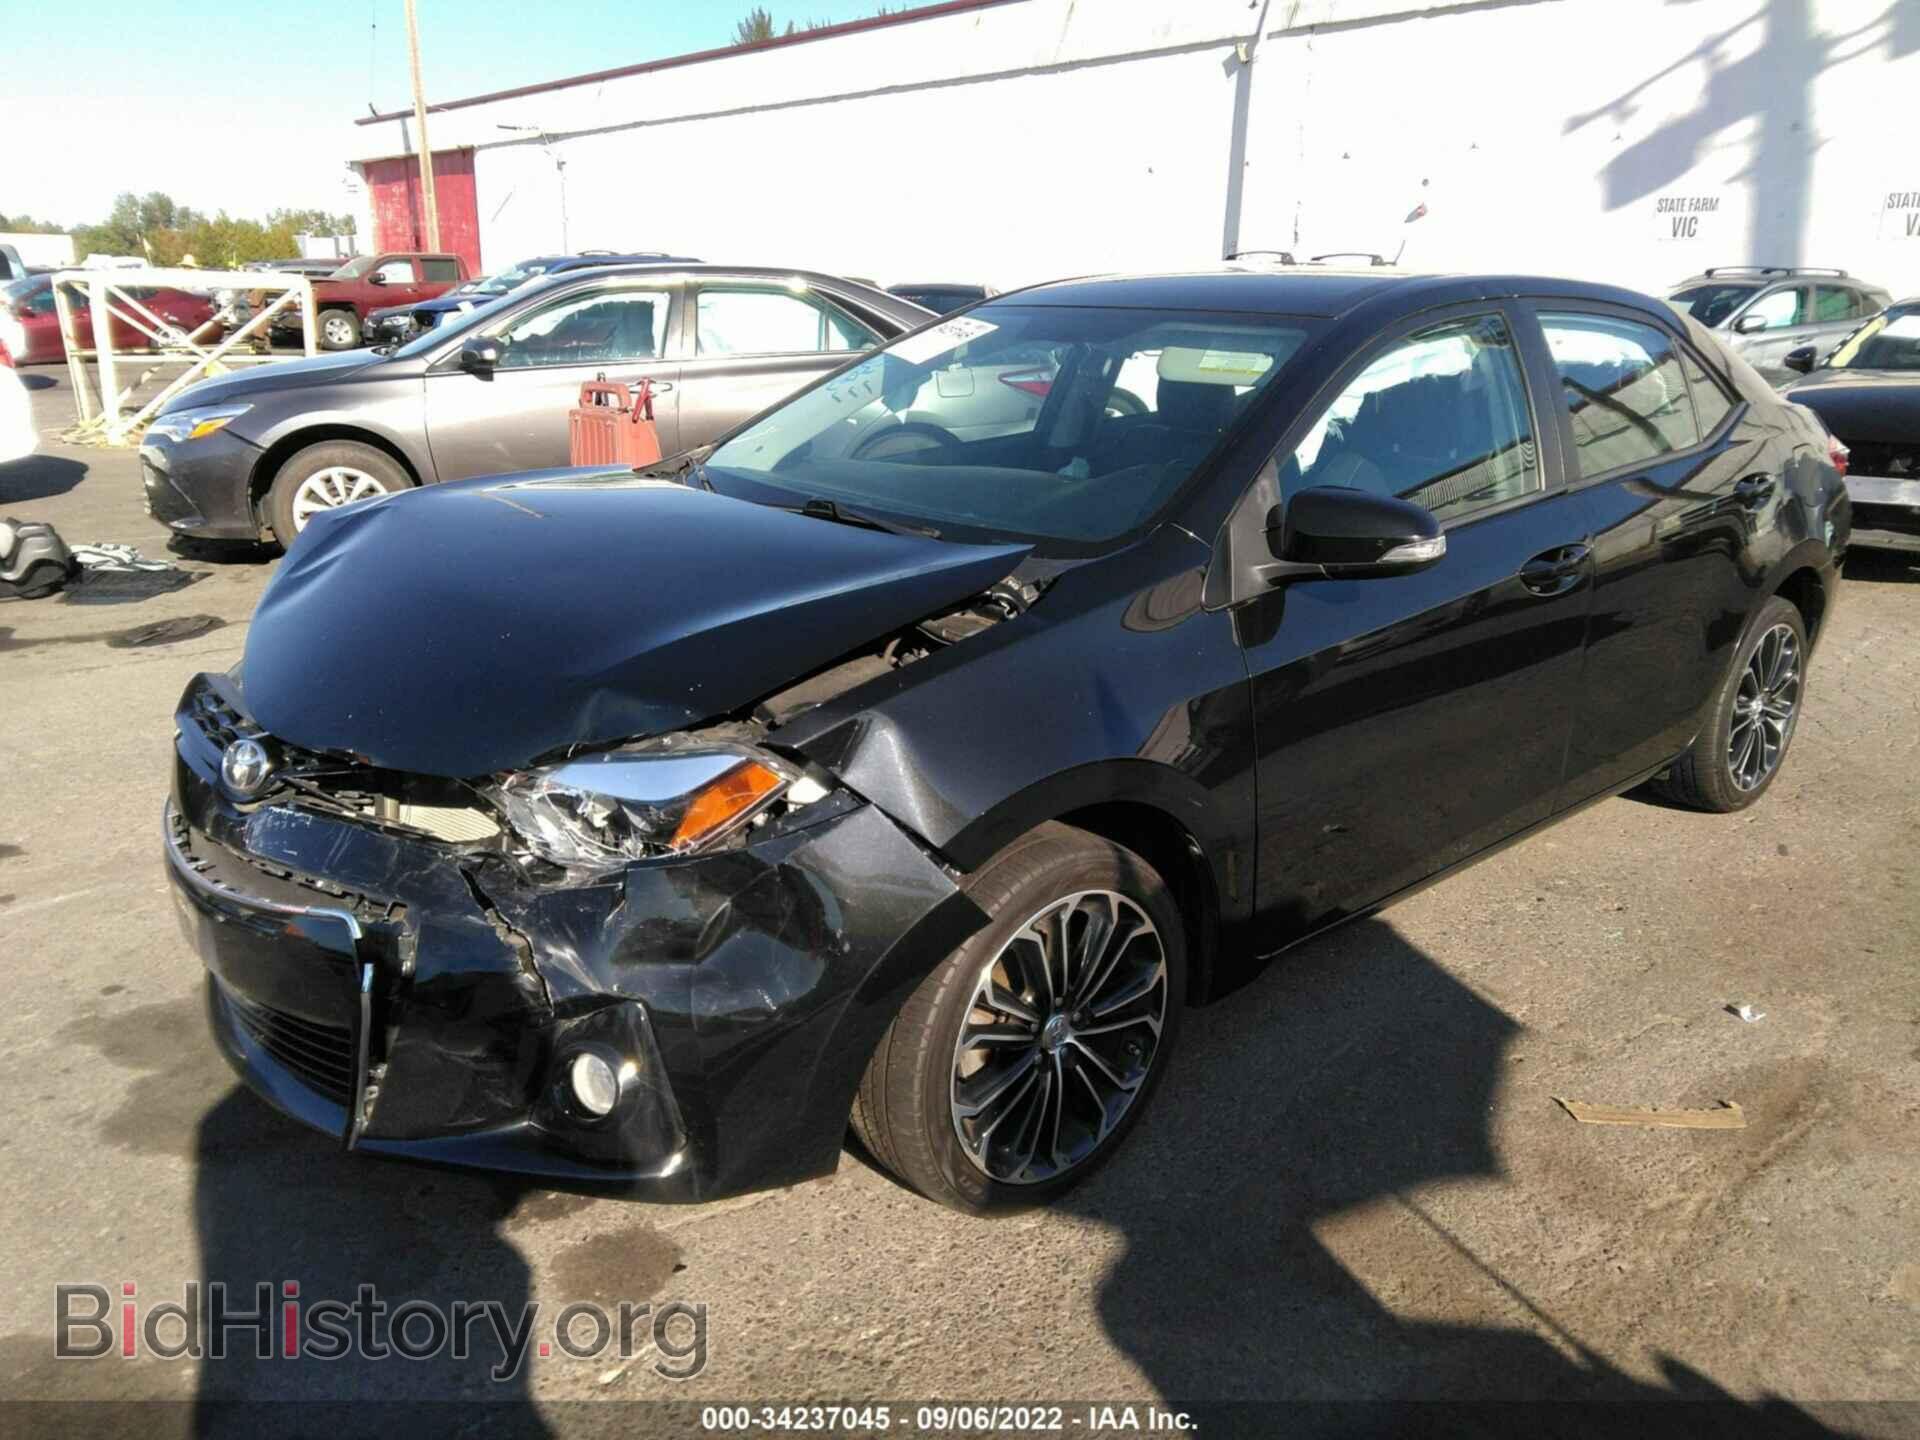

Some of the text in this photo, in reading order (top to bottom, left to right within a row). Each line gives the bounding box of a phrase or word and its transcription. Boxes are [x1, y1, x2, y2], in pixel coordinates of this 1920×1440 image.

[1656, 197, 1720, 213] STATE FARM
[1671, 215, 1699, 238] VIC
